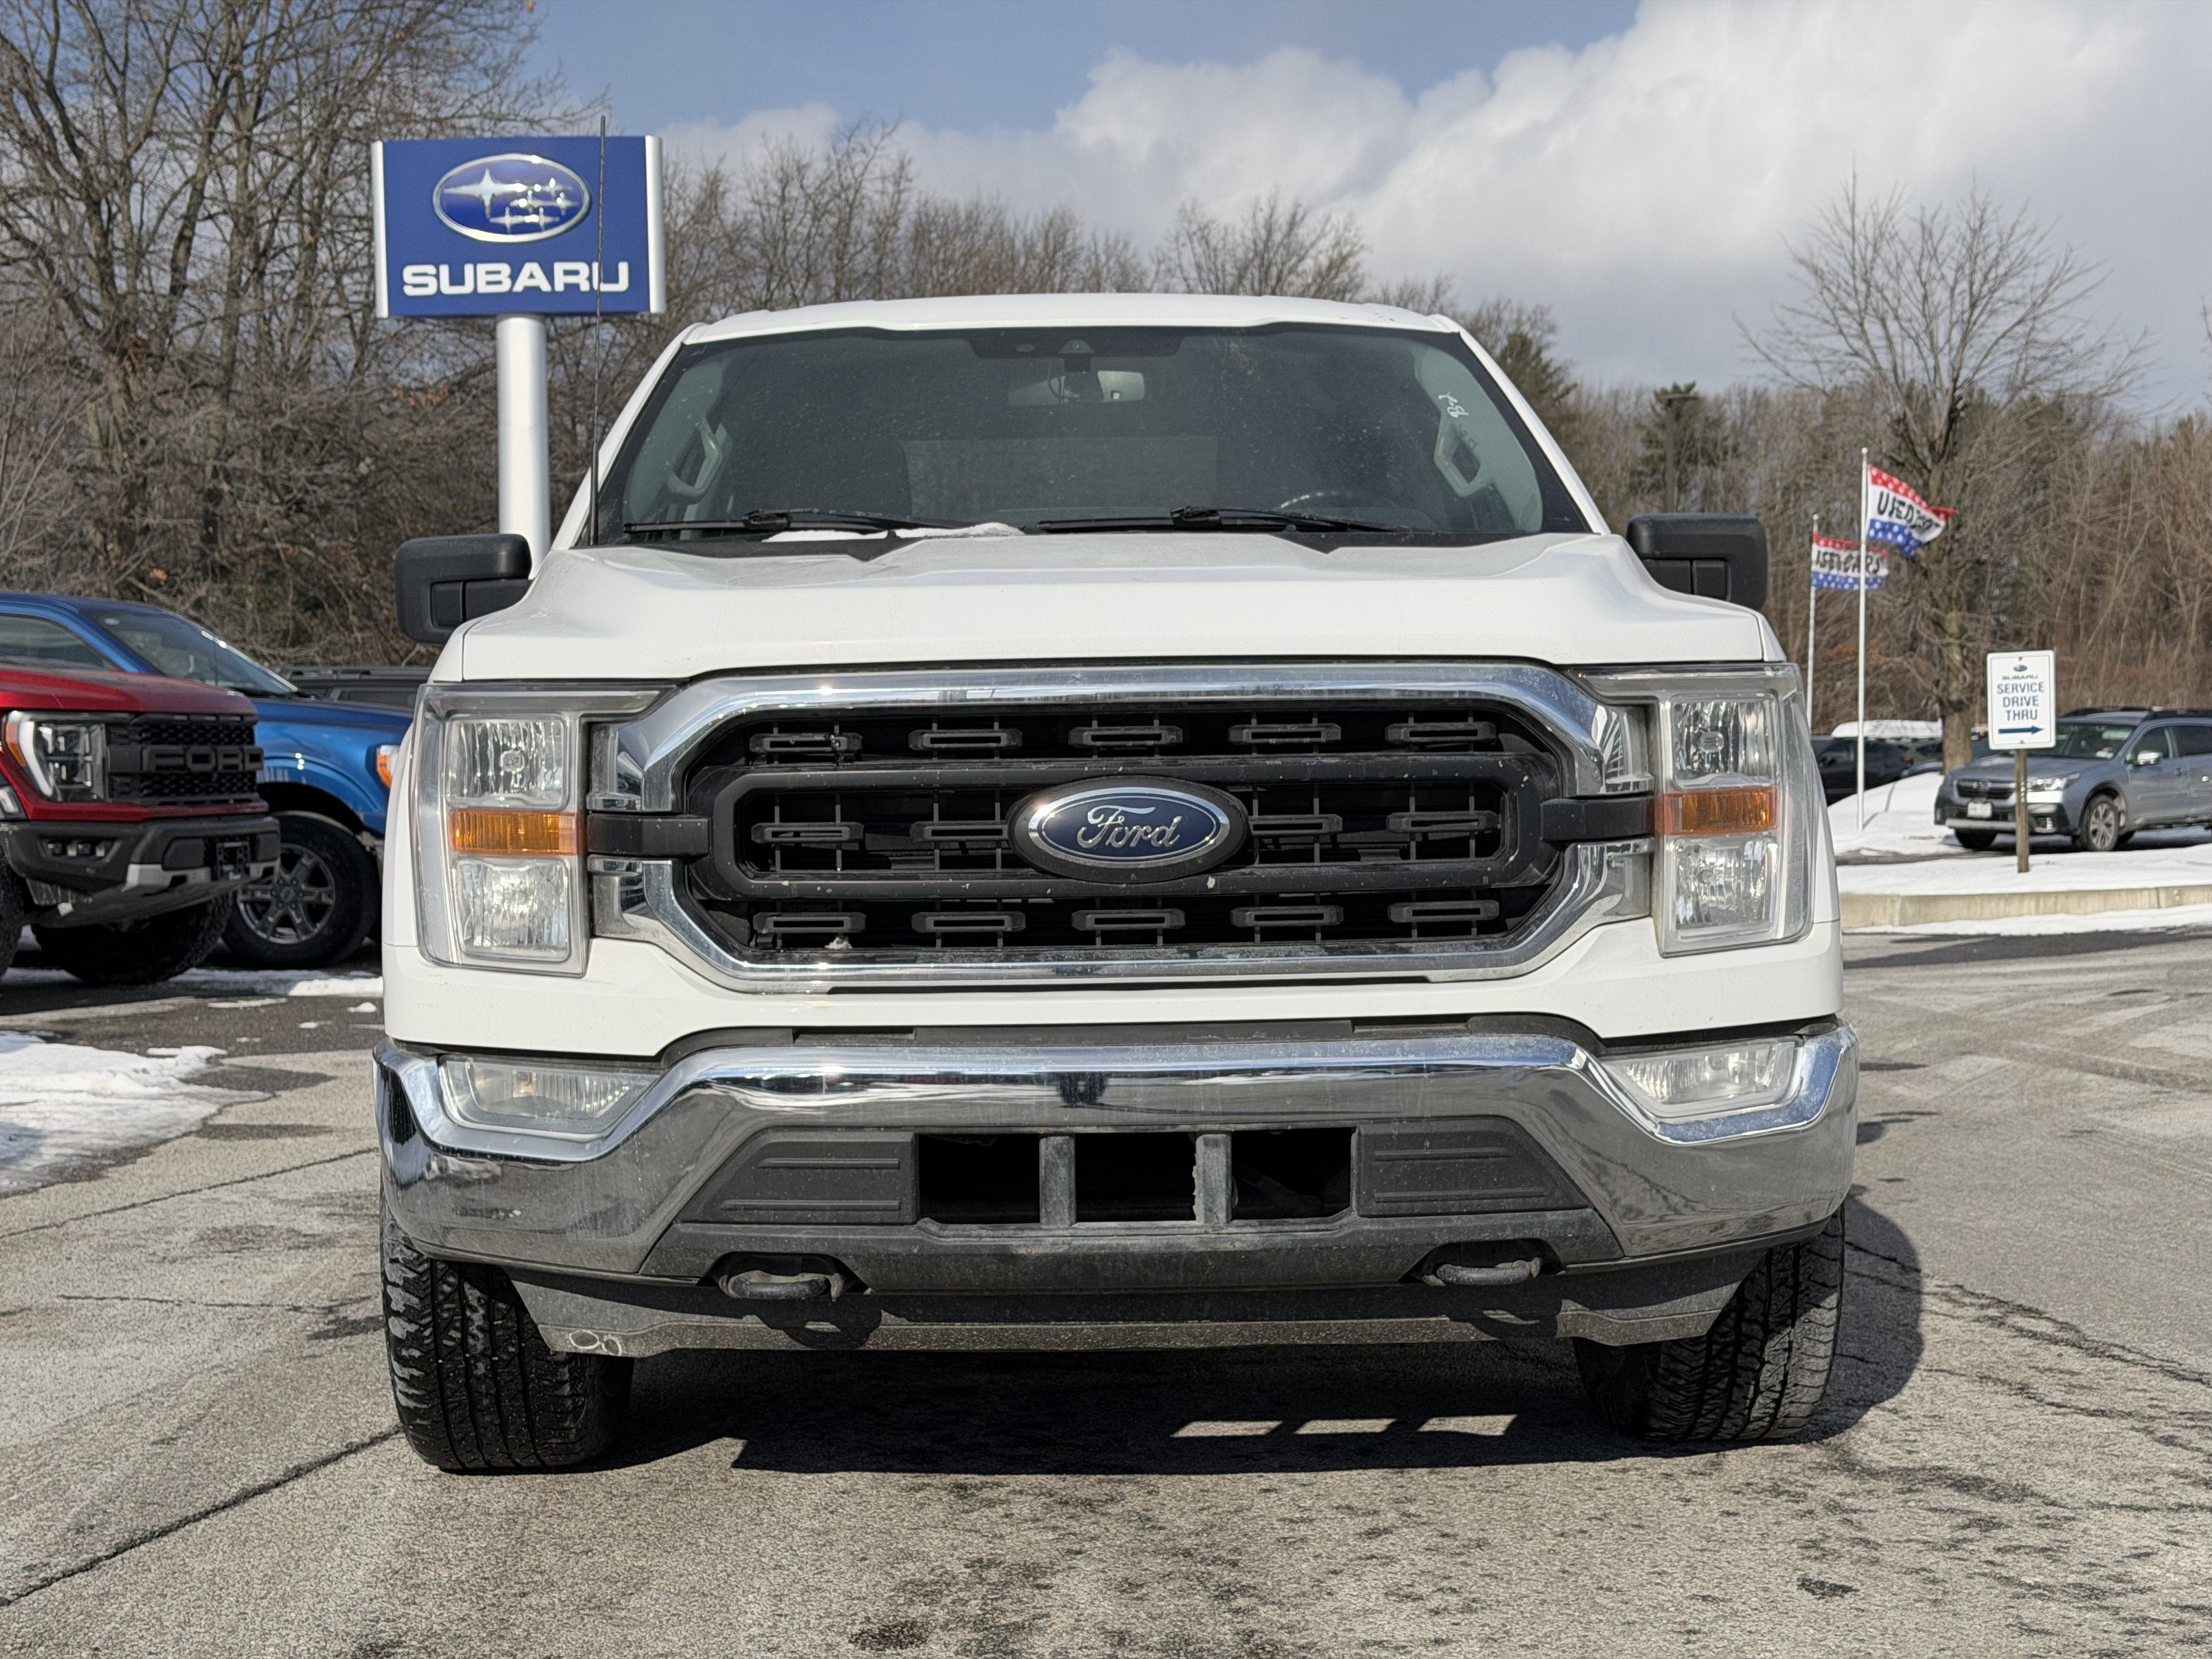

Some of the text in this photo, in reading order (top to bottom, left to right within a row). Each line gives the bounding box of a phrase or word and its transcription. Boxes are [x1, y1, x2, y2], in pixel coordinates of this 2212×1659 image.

[402, 261, 629, 297] SUBARU
[1996, 681, 2045, 695] SERVICE
[2002, 694, 2040, 708] DRIVE
[2005, 708, 2038, 721] THRU
[1076, 804, 1182, 848] Ford
